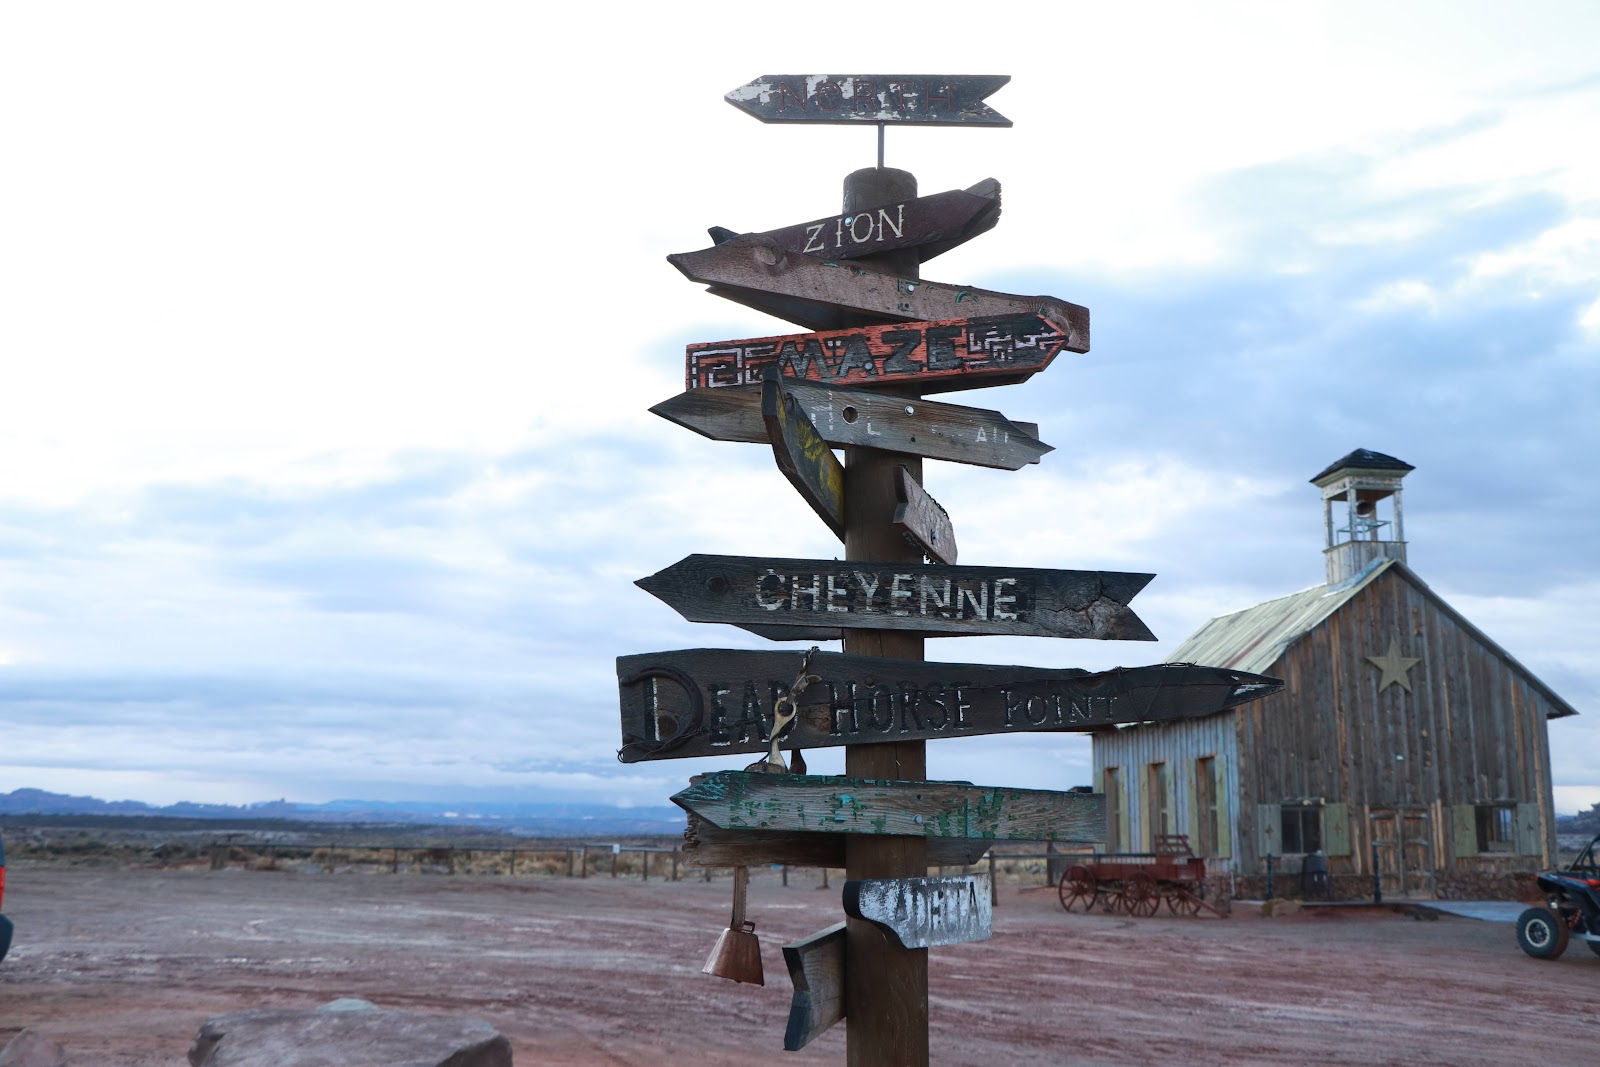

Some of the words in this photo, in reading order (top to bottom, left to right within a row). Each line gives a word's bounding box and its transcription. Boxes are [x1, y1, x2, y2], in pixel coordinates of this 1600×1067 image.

[778, 80, 952, 112] NORTH
[803, 204, 906, 254] ZION
[778, 326, 964, 379] MAZE
[755, 568, 1018, 621] CHEYENNE
[825, 681, 973, 737] HORSE
[1000, 689, 1118, 728] POINT
